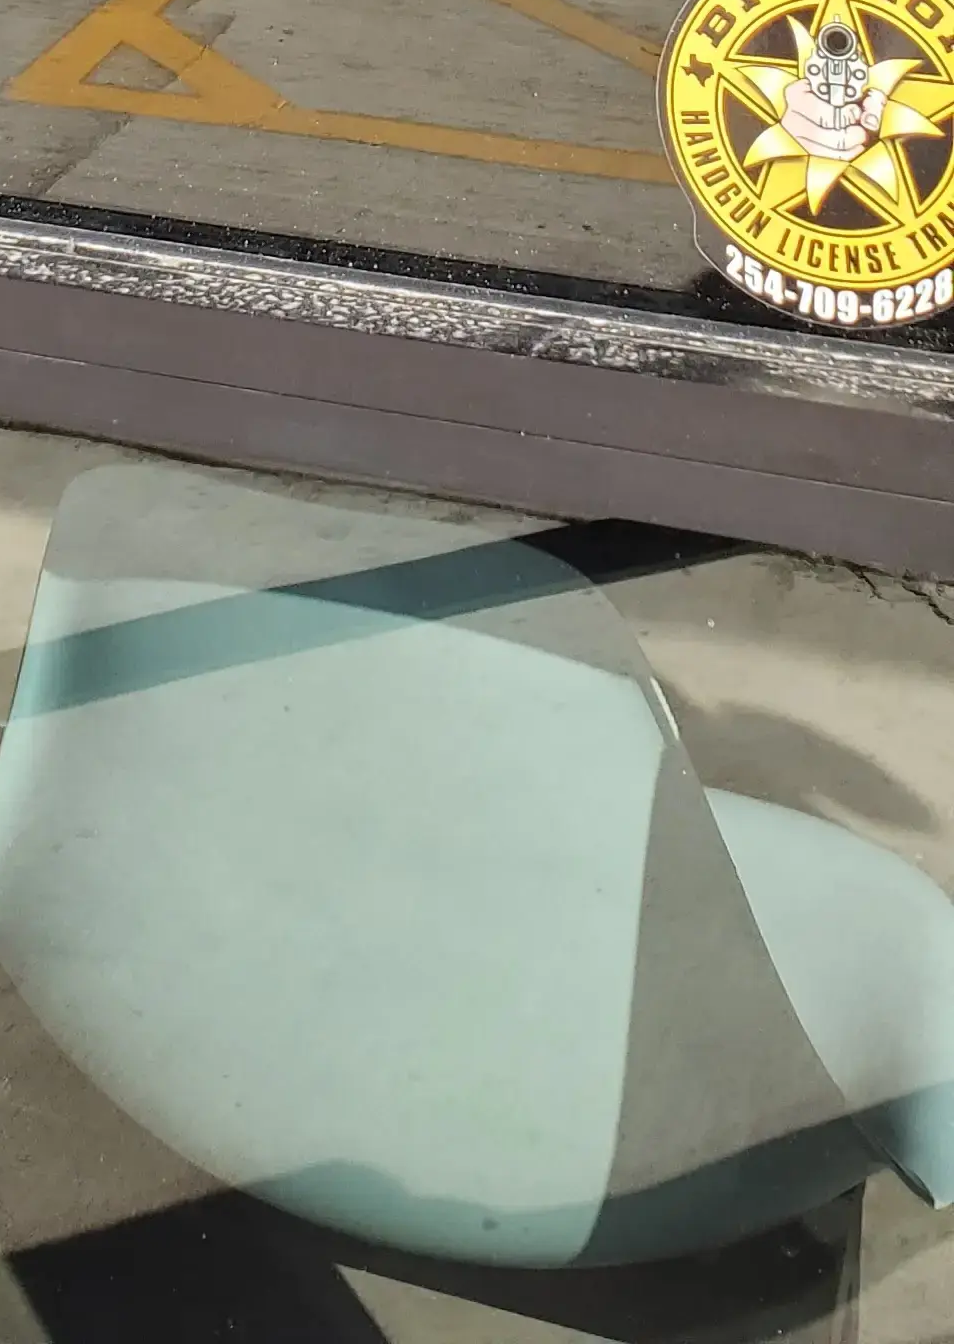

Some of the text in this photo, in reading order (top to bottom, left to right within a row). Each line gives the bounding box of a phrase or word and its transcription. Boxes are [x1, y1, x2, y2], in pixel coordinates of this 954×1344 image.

[680, 110, 772, 240] HANDGUN
[776, 227, 902, 275] LICENSE
[724, 243, 954, 324] 254-709-6228
